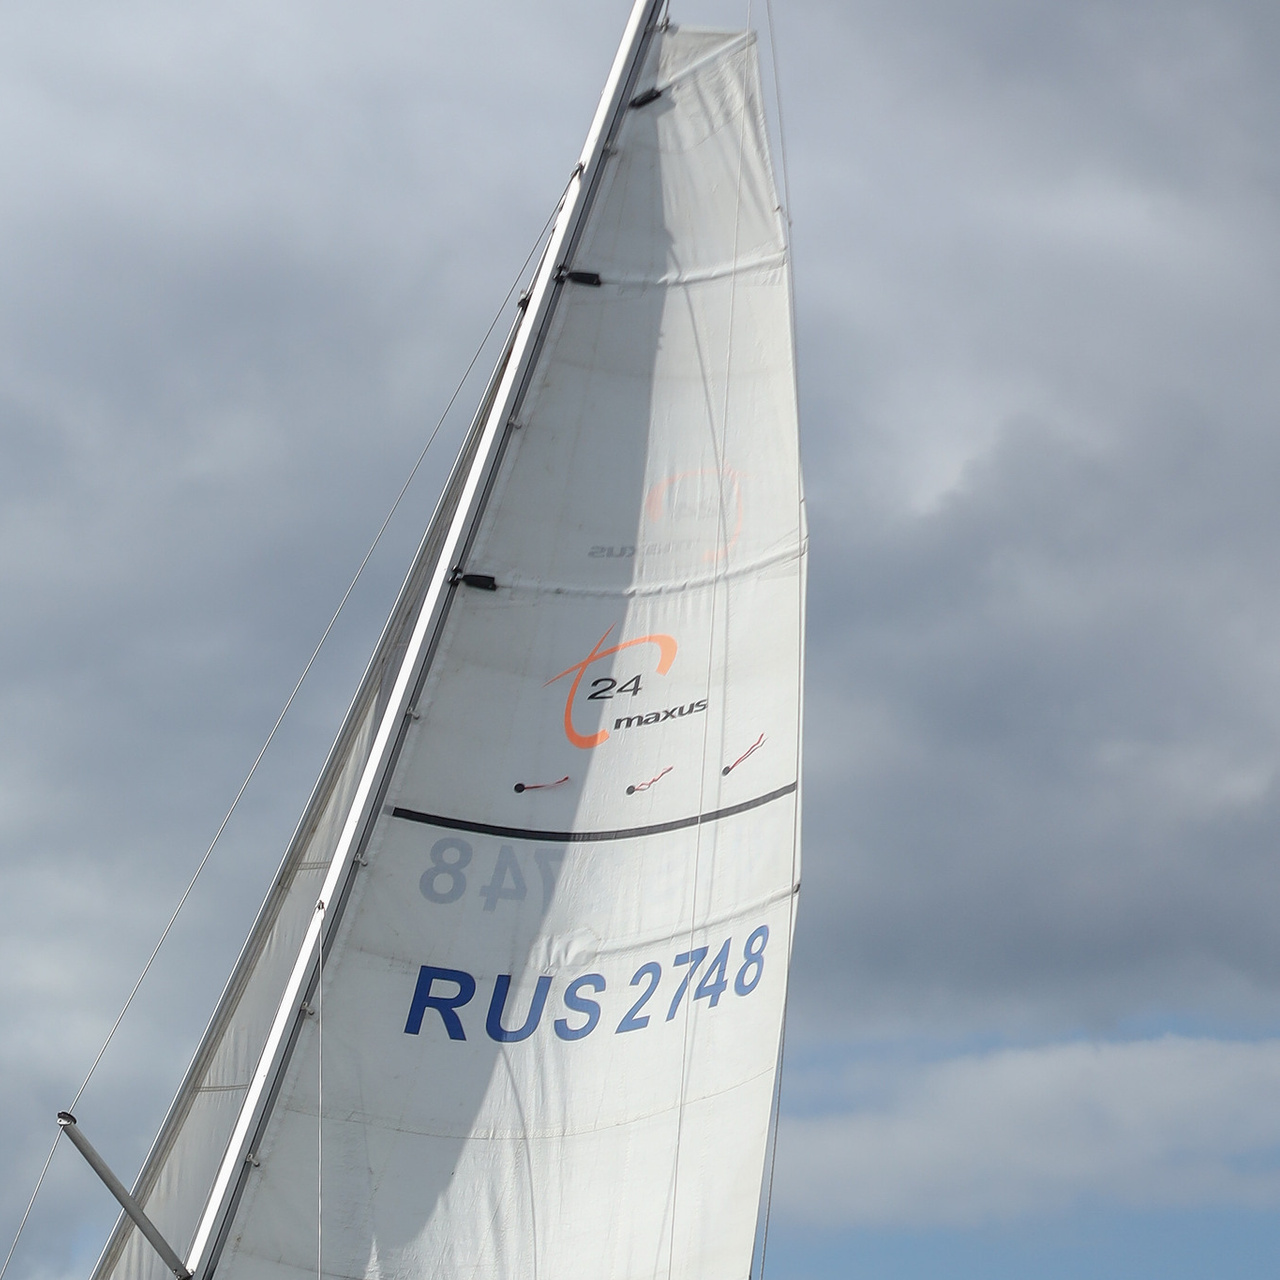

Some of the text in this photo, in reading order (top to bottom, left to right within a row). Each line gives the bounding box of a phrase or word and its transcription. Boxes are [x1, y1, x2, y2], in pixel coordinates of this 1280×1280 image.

[587, 674, 642, 700] 24
[614, 699, 708, 730] maxus
[403, 925, 770, 1043] RUS 2748
